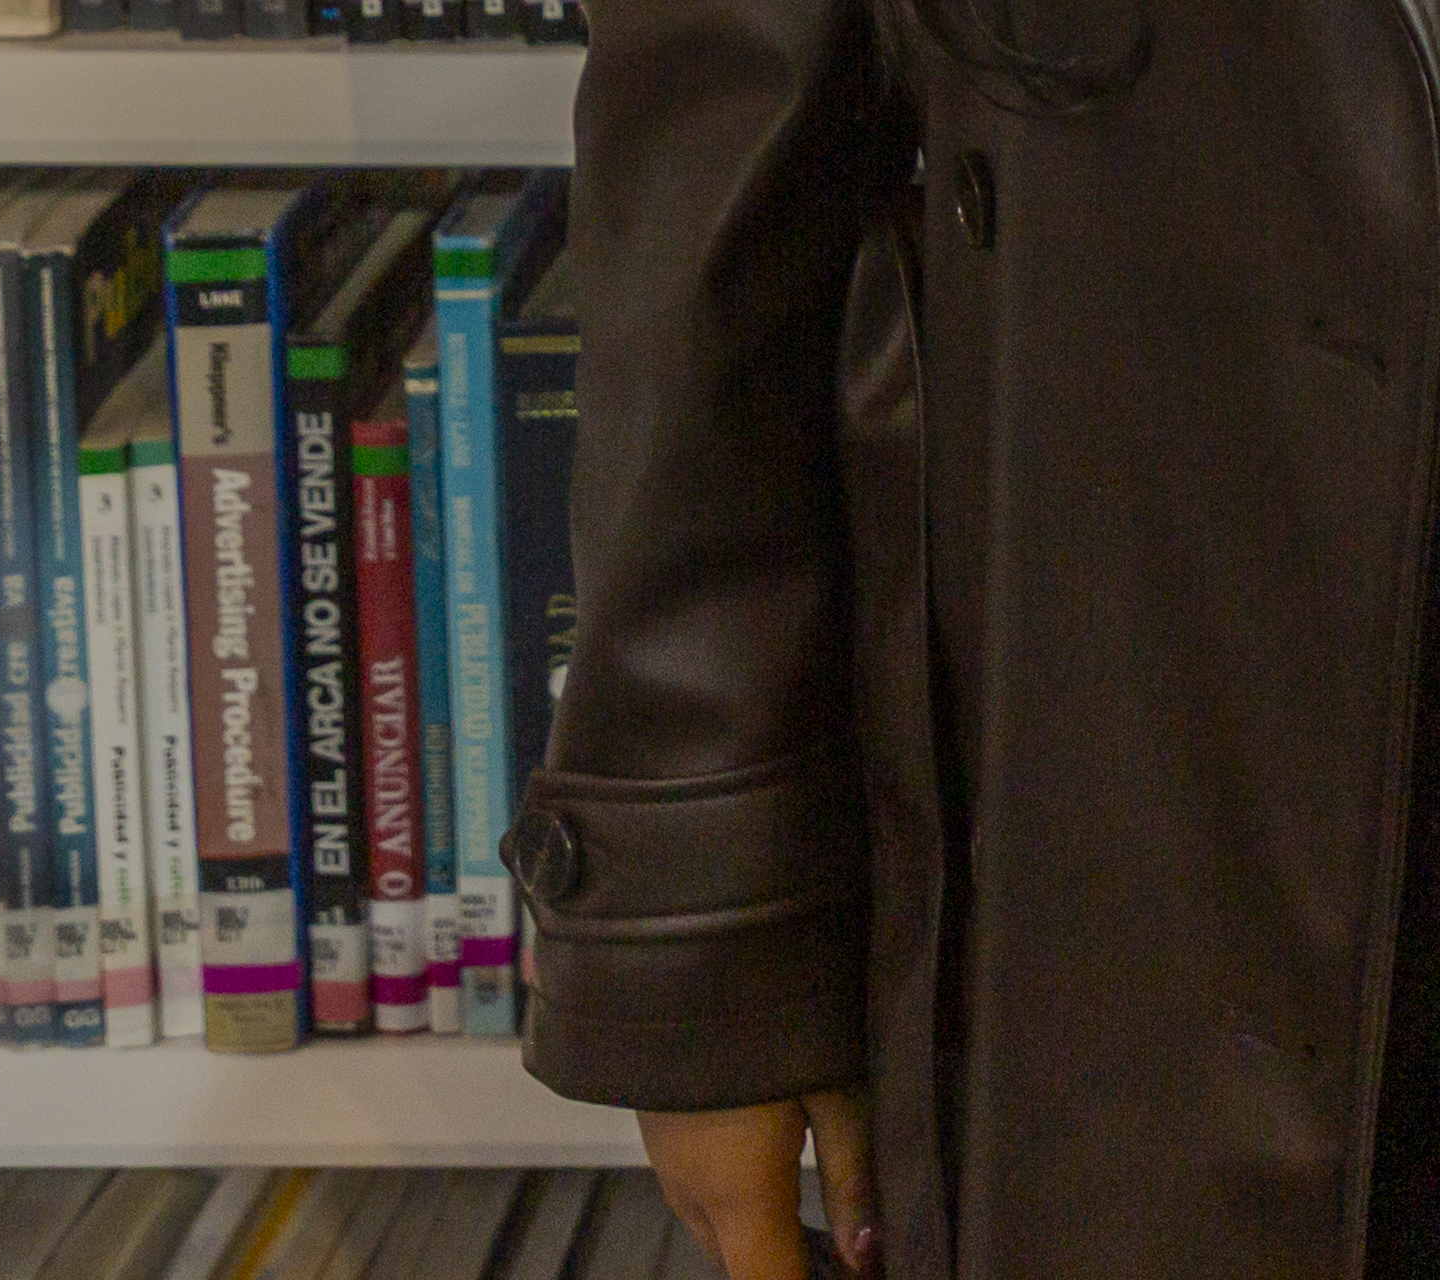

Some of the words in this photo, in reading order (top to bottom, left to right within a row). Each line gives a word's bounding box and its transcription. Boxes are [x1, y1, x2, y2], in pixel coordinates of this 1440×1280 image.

[295, 411, 337, 536] VENDE
[212, 468, 256, 659] Advertising
[302, 540, 340, 592] SE
[304, 599, 342, 655] NO
[220, 669, 263, 843] Procedure
[307, 667, 347, 766] ARCA
[371, 658, 414, 857] ANUNCIAR
[310, 780, 349, 823] EL
[312, 826, 351, 876] EN
